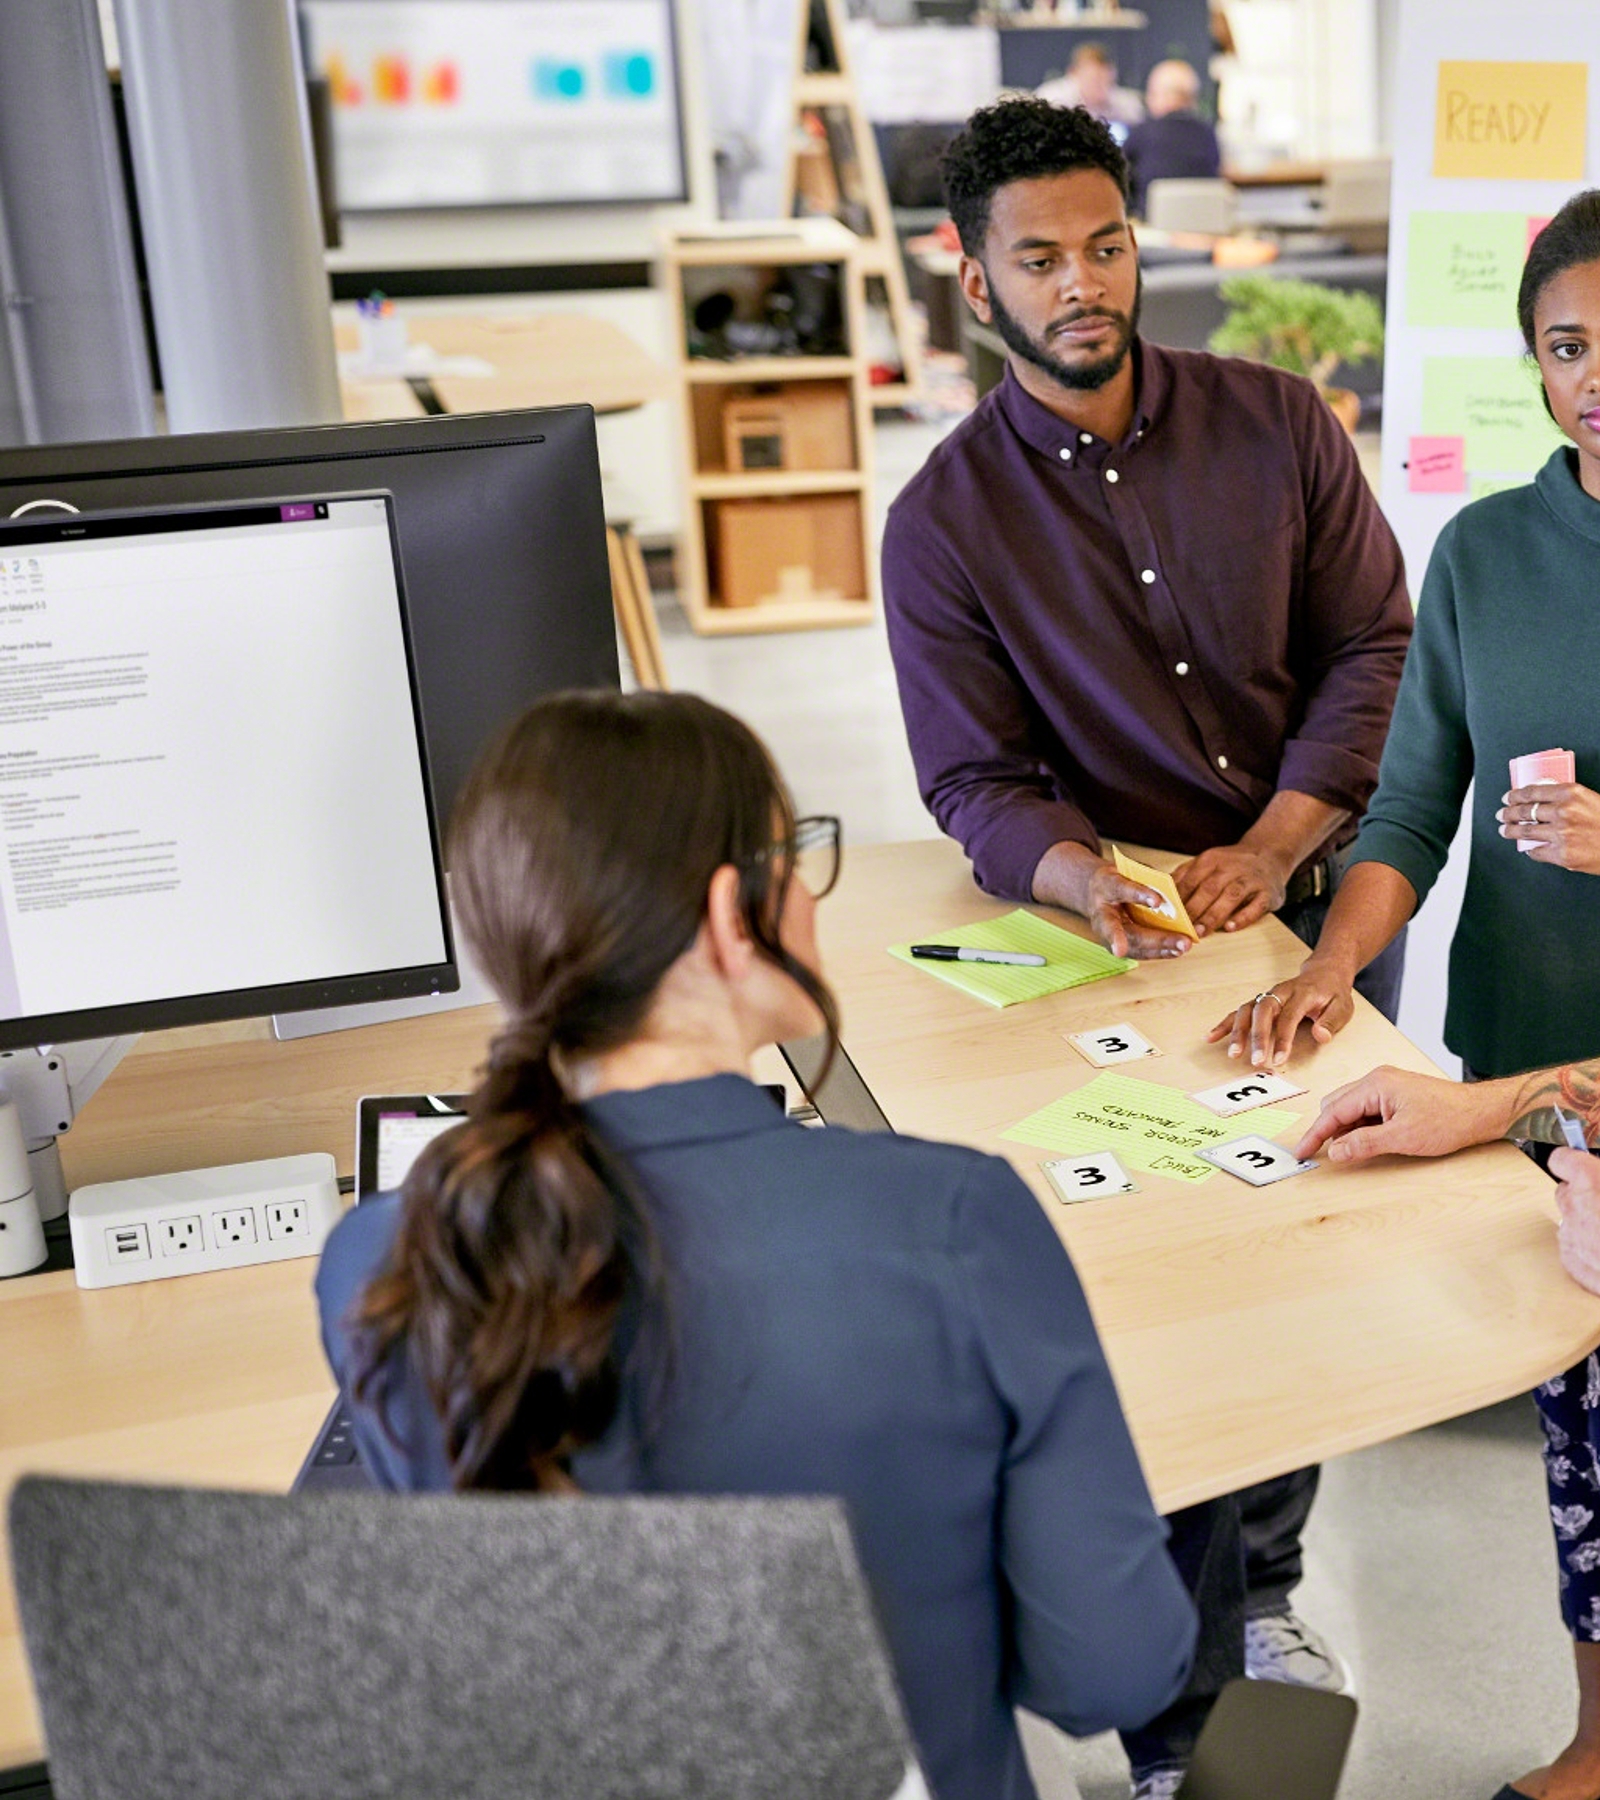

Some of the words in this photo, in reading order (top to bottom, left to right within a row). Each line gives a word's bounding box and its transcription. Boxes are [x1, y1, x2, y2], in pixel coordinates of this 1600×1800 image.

[1445, 90, 1550, 144] READY
[1097, 1037, 1129, 1053] 3
[1226, 1085, 1269, 1102] 3
[1144, 1128, 1203, 1148] ERROR
[1235, 1150, 1276, 1169] 3
[1073, 1166, 1107, 1187] 3
